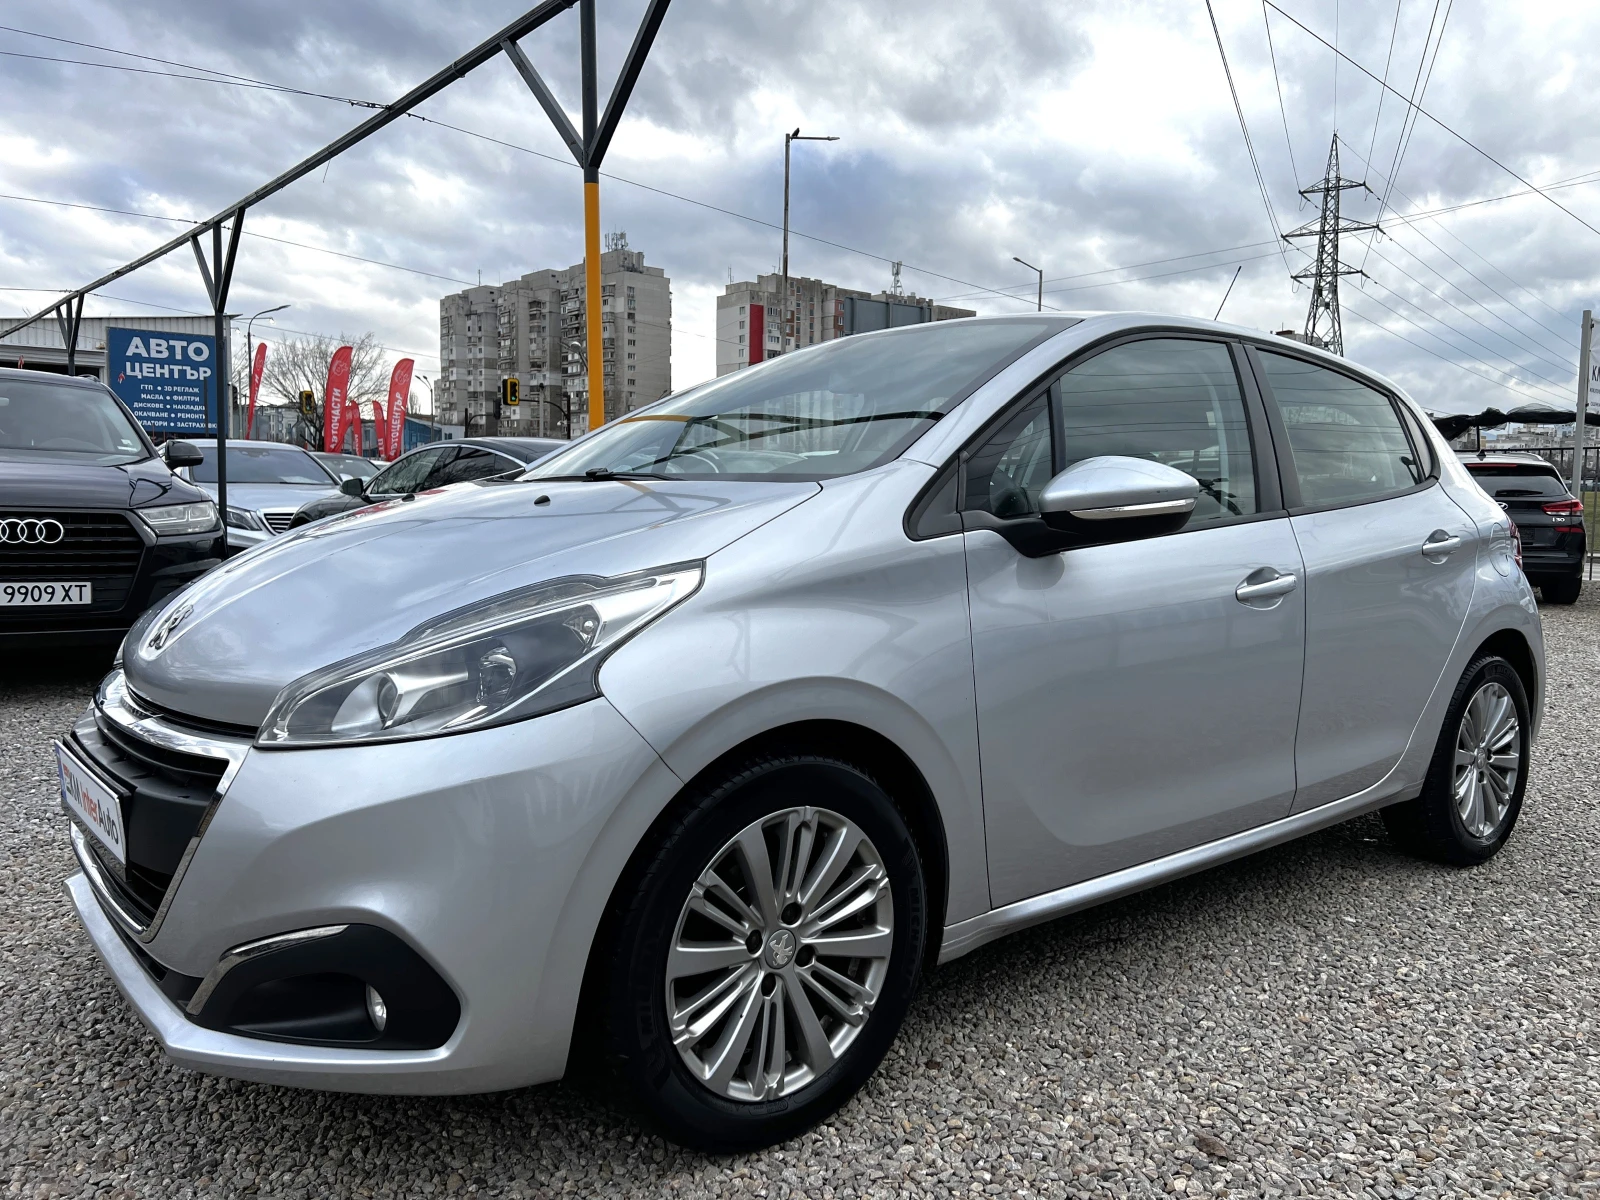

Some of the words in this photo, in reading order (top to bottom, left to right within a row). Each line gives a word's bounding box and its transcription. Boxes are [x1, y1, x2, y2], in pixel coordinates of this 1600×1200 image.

[125, 336, 210, 362] АВТО
[125, 361, 212, 381] ЦЕНТЪР
[140, 393, 164, 401] МАСЛА
[172, 394, 200, 402] ФИЛТРИ
[173, 386, 200, 394] РЕГЛАЖ
[134, 410, 169, 418] ОКАЧВАНЕ
[330, 387, 342, 449] АВТОЧАСТИ
[389, 391, 403, 456] АВТОЦЕНТЪР
[3, 584, 56, 603] 9909
[60, 584, 88, 602] XT
